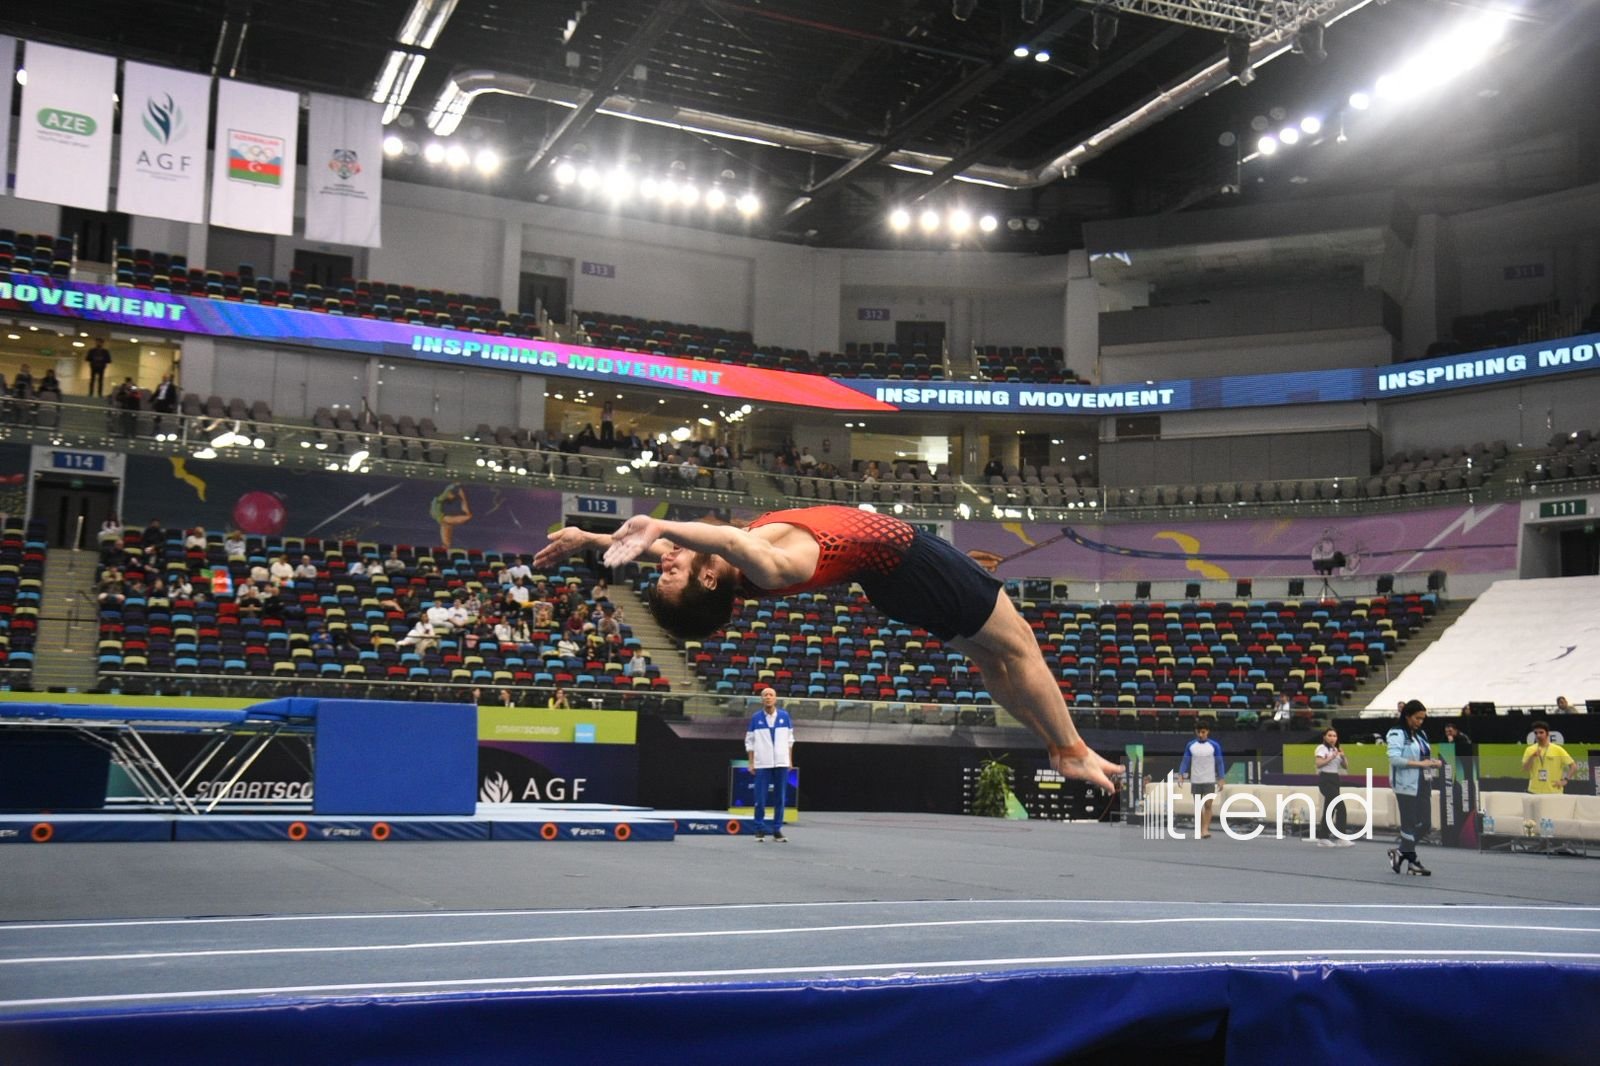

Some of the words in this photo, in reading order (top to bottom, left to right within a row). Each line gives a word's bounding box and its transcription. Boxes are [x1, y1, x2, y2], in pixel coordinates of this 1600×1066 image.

[45, 112, 87, 133] AZE
[412, 335, 557, 367] INSPIRING
[567, 354, 724, 385] MOVEMENT
[1378, 354, 1527, 392] INSPIRING
[876, 387, 1009, 406] INSPIRING
[1019, 388, 1175, 408] MOVEMENT
[64, 454, 94, 469] 114
[586, 499, 609, 513] 113
[1552, 501, 1575, 515] 111
[521, 777, 587, 801] AGF
